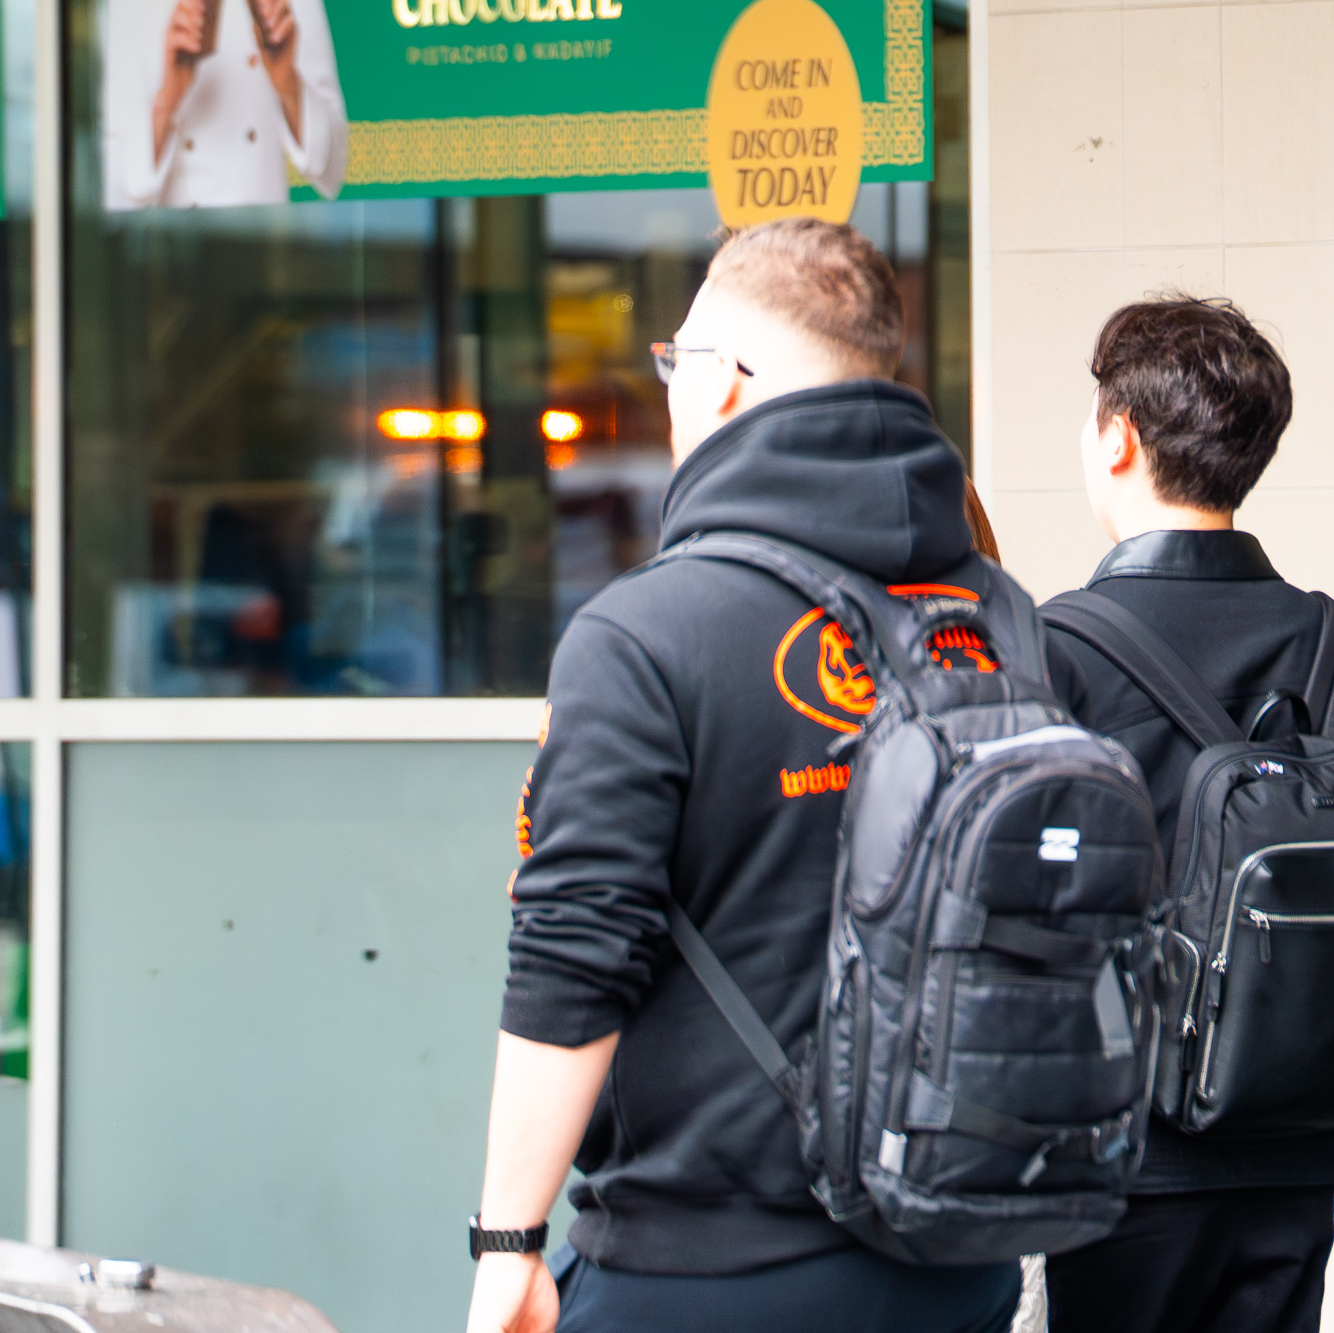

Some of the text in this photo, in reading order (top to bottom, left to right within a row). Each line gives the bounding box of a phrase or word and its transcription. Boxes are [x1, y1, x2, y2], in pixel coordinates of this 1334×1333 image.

[735, 57, 833, 91] COME IN
[767, 96, 803, 119] AND
[730, 127, 839, 160] DISCOVER
[735, 167, 837, 208] TODAY
